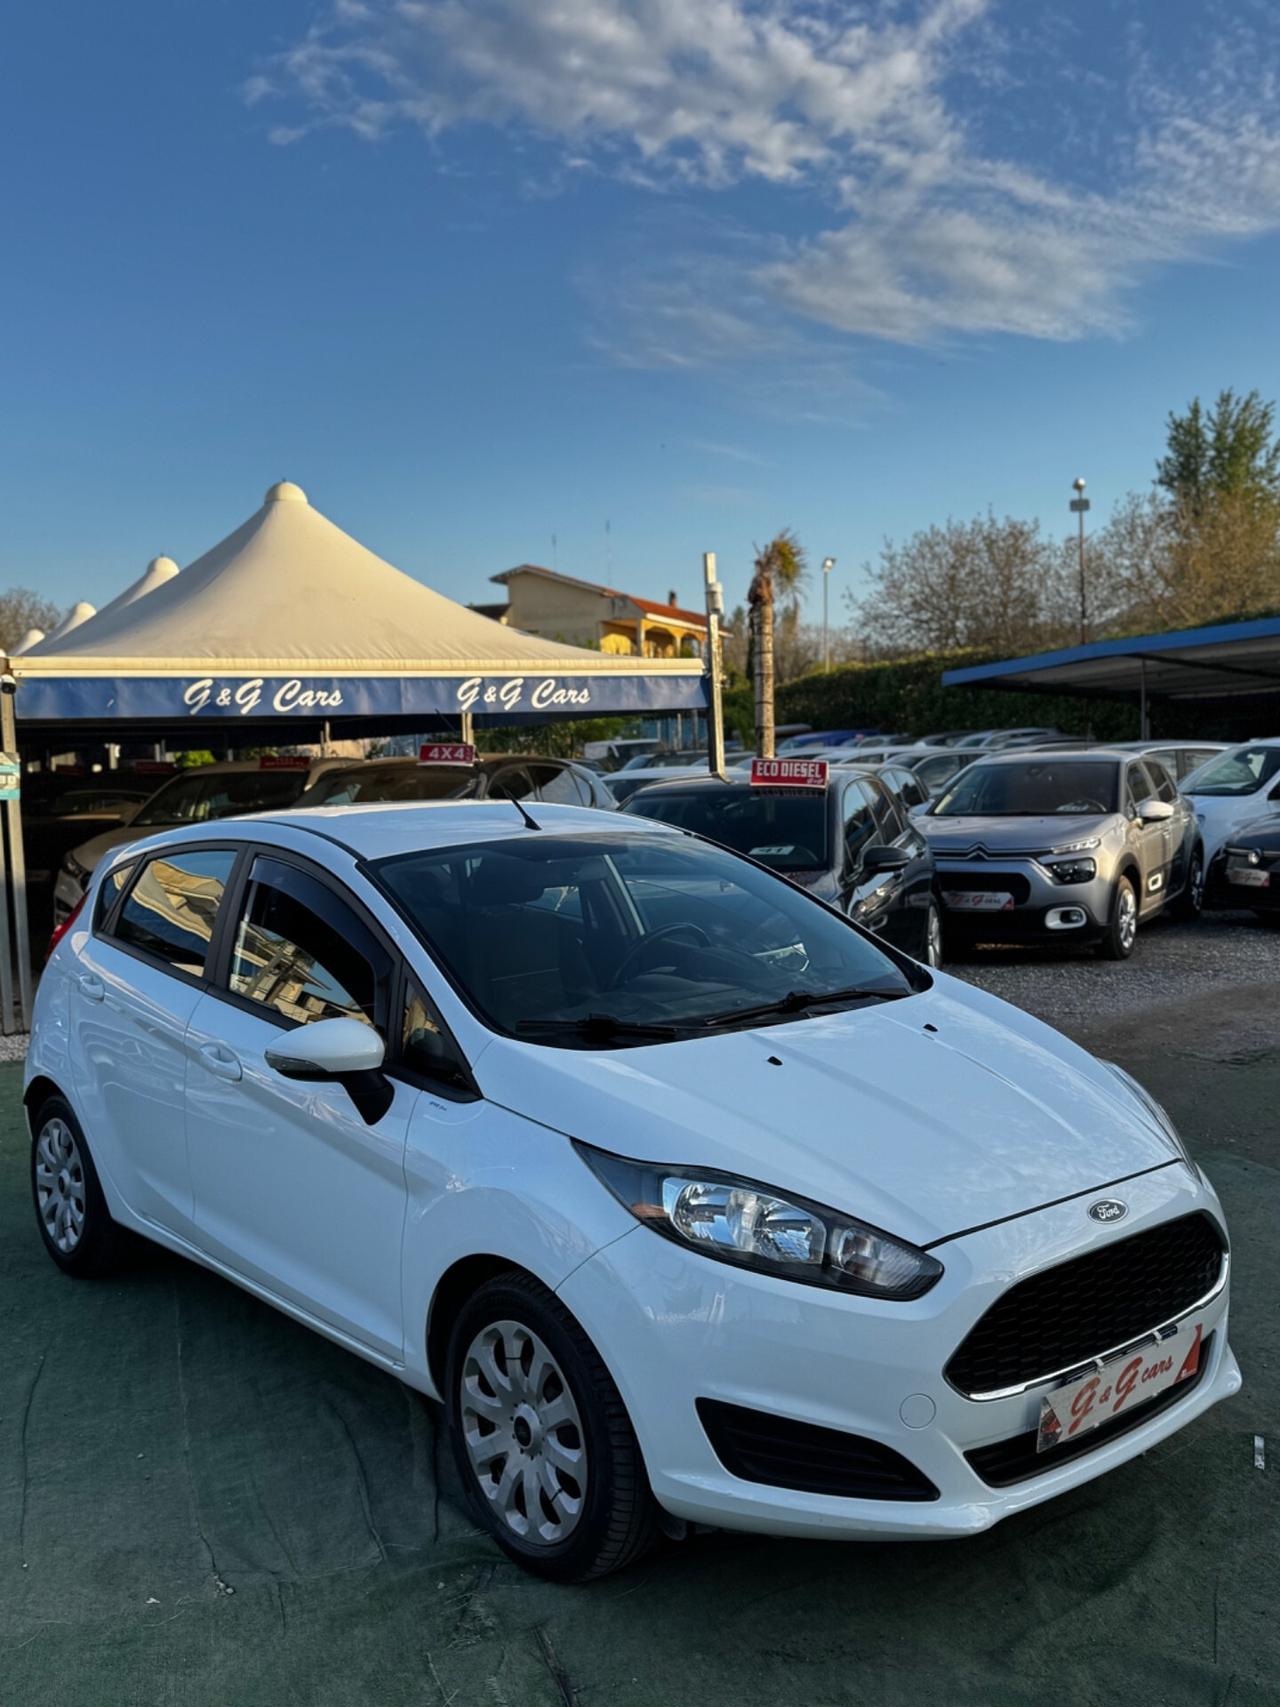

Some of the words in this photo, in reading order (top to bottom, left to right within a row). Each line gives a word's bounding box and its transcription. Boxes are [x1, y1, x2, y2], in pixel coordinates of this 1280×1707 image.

[273, 679, 344, 712] Cars
[531, 679, 591, 709] Cars
[756, 761, 779, 777] ECO
[780, 762, 822, 778] DIESEL
[1097, 1203, 1120, 1219] Ford
[1141, 1355, 1174, 1383] cars
